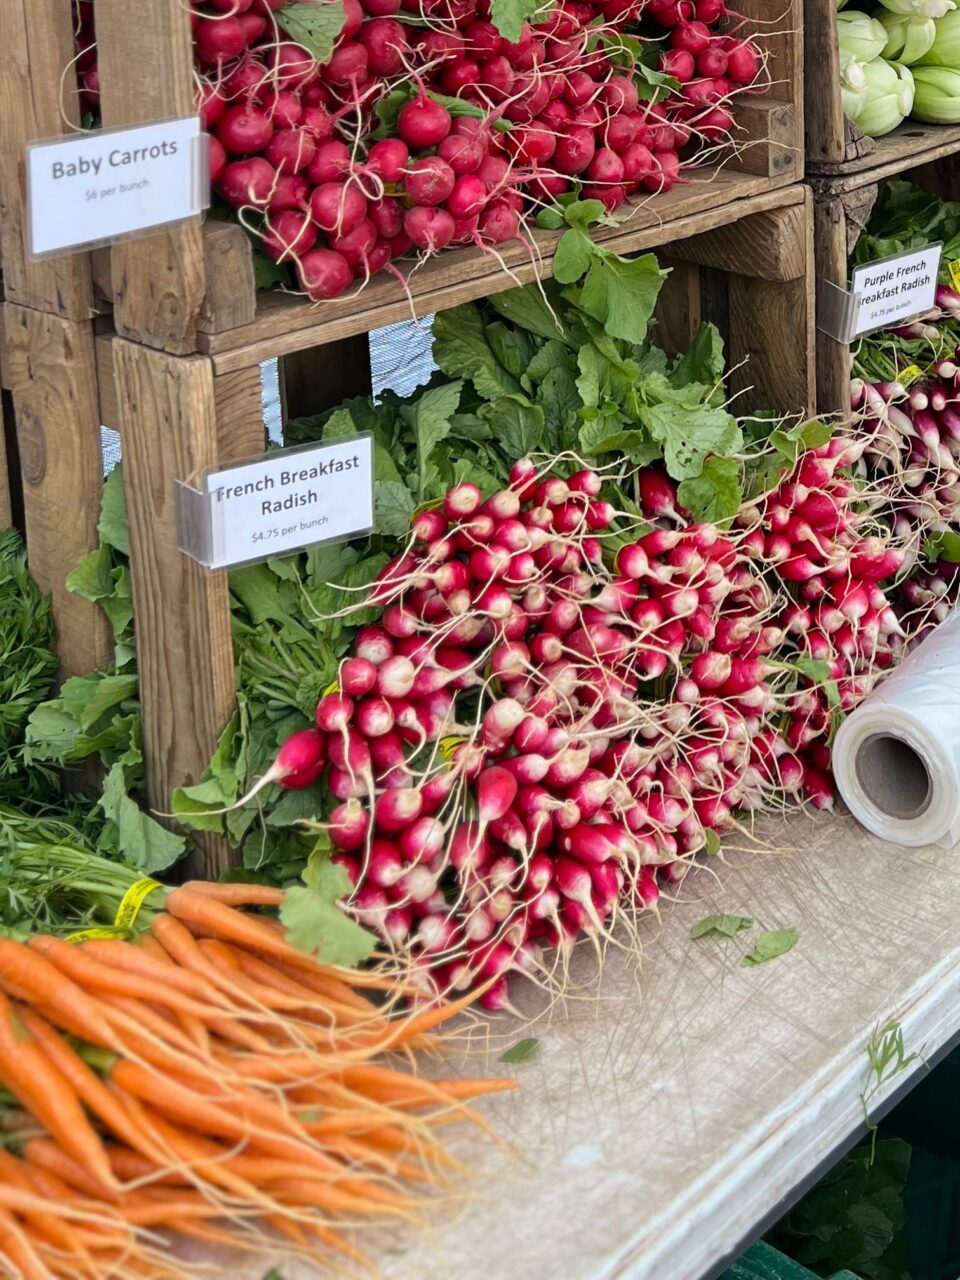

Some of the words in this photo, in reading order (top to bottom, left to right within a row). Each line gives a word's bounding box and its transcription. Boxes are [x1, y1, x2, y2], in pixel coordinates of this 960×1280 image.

[52, 155, 103, 180] Baby
[108, 140, 178, 167] Carrots
[85, 190, 98, 201] $6
[100, 187, 118, 199] per
[119, 179, 150, 193] bunch
[864, 270, 895, 288] Purple
[896, 259, 927, 278] French
[901, 275, 930, 293] Radish
[886, 306, 896, 315] per
[216, 474, 275, 503] French
[280, 455, 360, 486] Breakfast
[261, 489, 318, 515] Radish
[252, 529, 279, 543] $4.75
[281, 524, 298, 537] per
[299, 516, 329, 530] bunch
